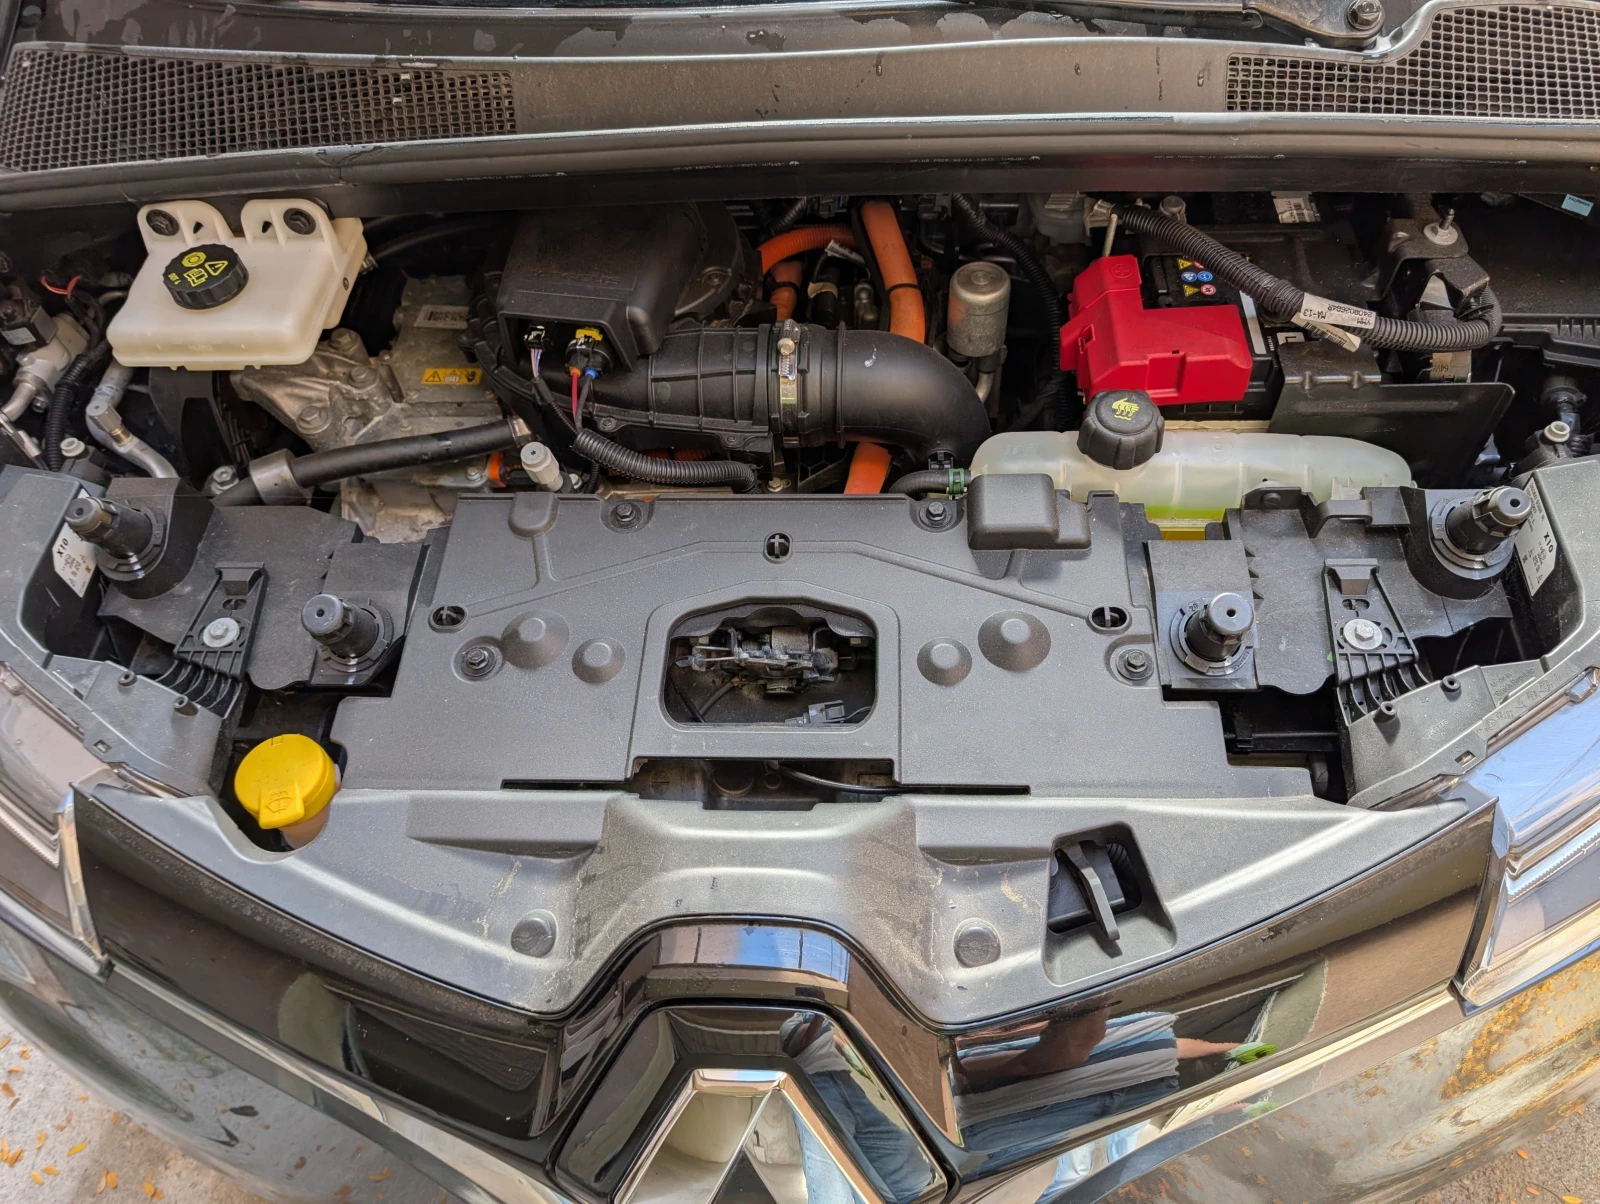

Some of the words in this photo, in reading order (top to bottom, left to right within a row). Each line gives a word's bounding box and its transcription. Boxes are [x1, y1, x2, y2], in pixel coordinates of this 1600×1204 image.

[1303, 308, 1327, 320] MA-13
[56, 538, 69, 558] X10
[1543, 532, 1554, 553] X10
[1189, 603, 1199, 612] 20
